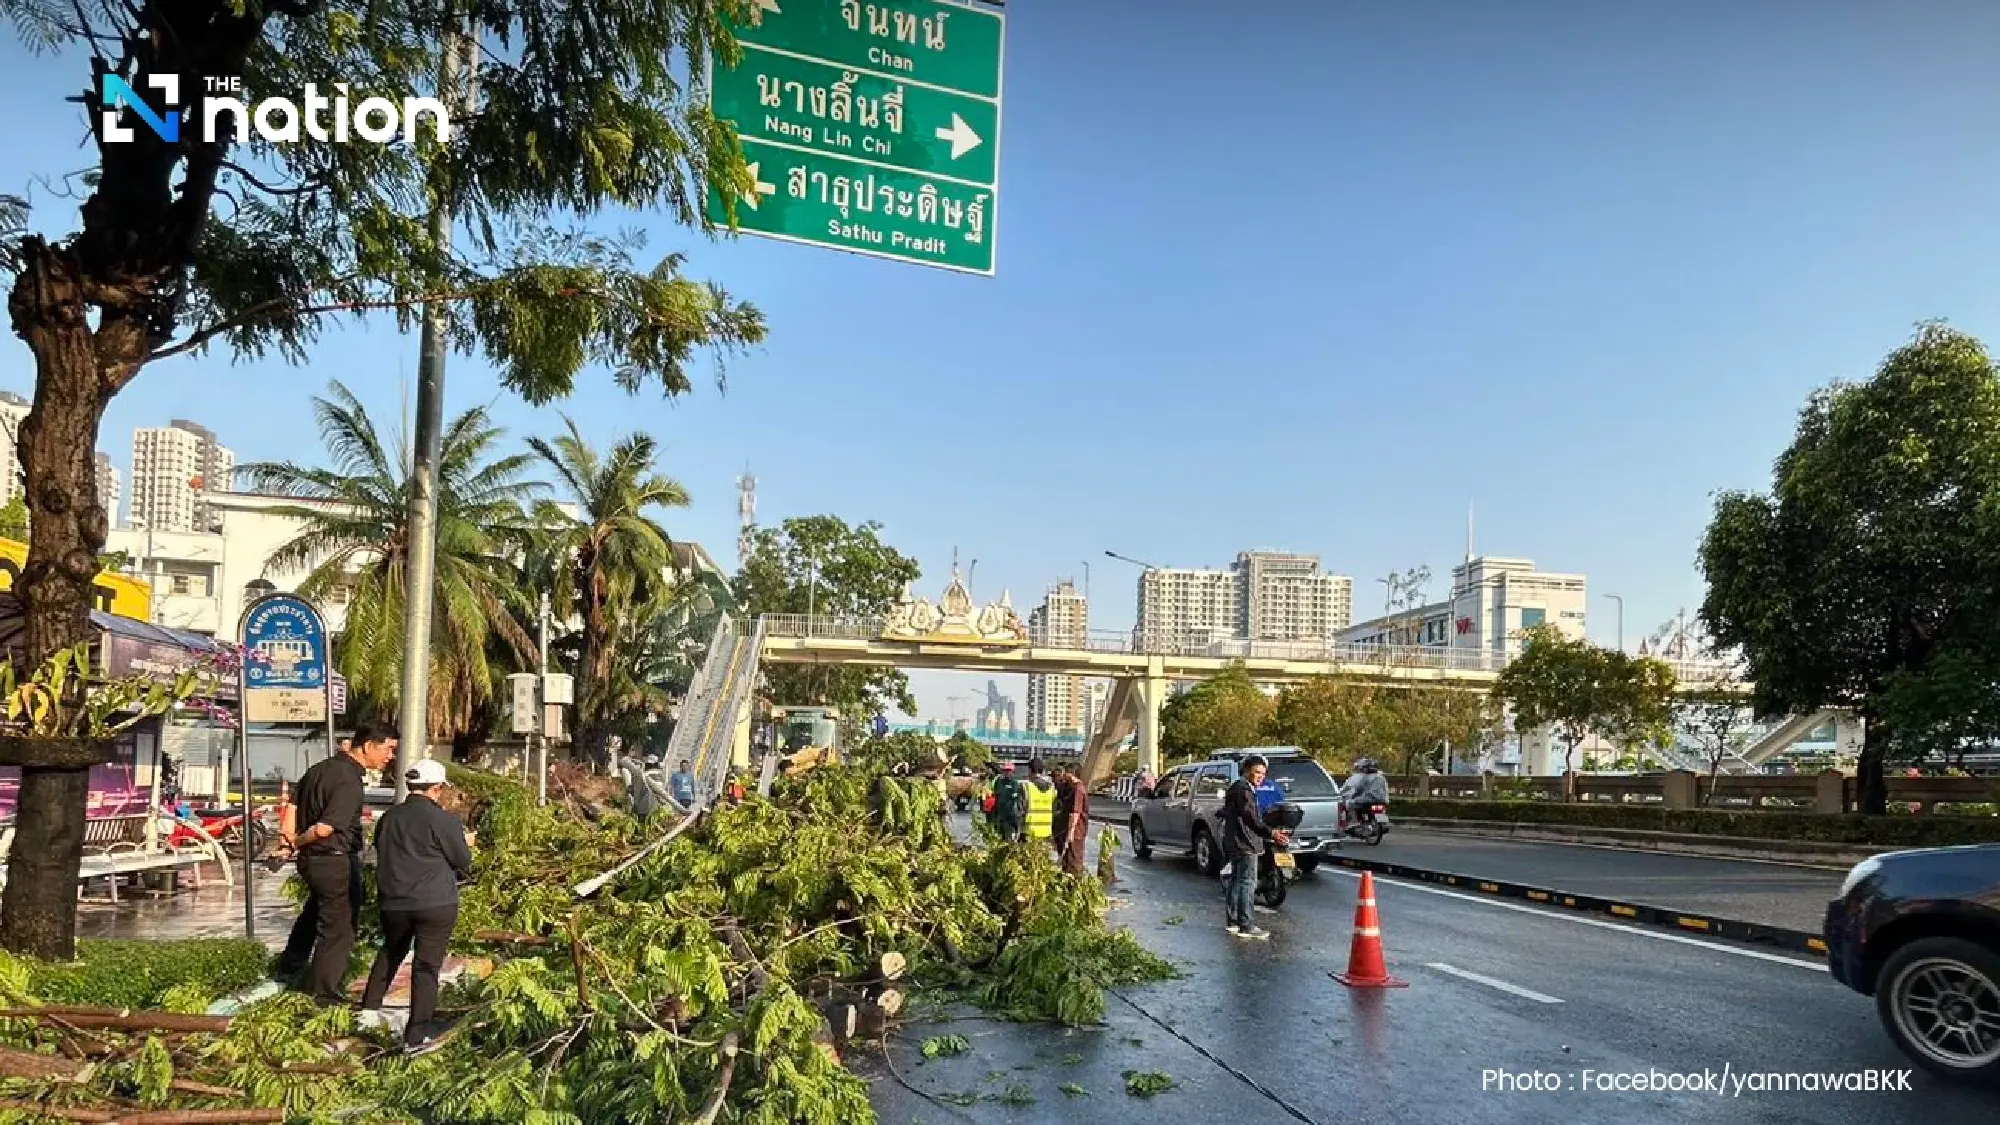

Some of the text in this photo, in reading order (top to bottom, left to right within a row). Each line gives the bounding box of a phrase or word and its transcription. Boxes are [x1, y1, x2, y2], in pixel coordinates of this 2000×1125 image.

[840, 0, 951, 51] จนทน์
[868, 46, 914, 72] Chan
[757, 70, 903, 134] นางลิ้นจี่
[765, 114, 892, 155] Nang Lin Chi
[787, 165, 989, 243] สาธุประดิษฐ์
[828, 219, 946, 255] Sathu Pradit
